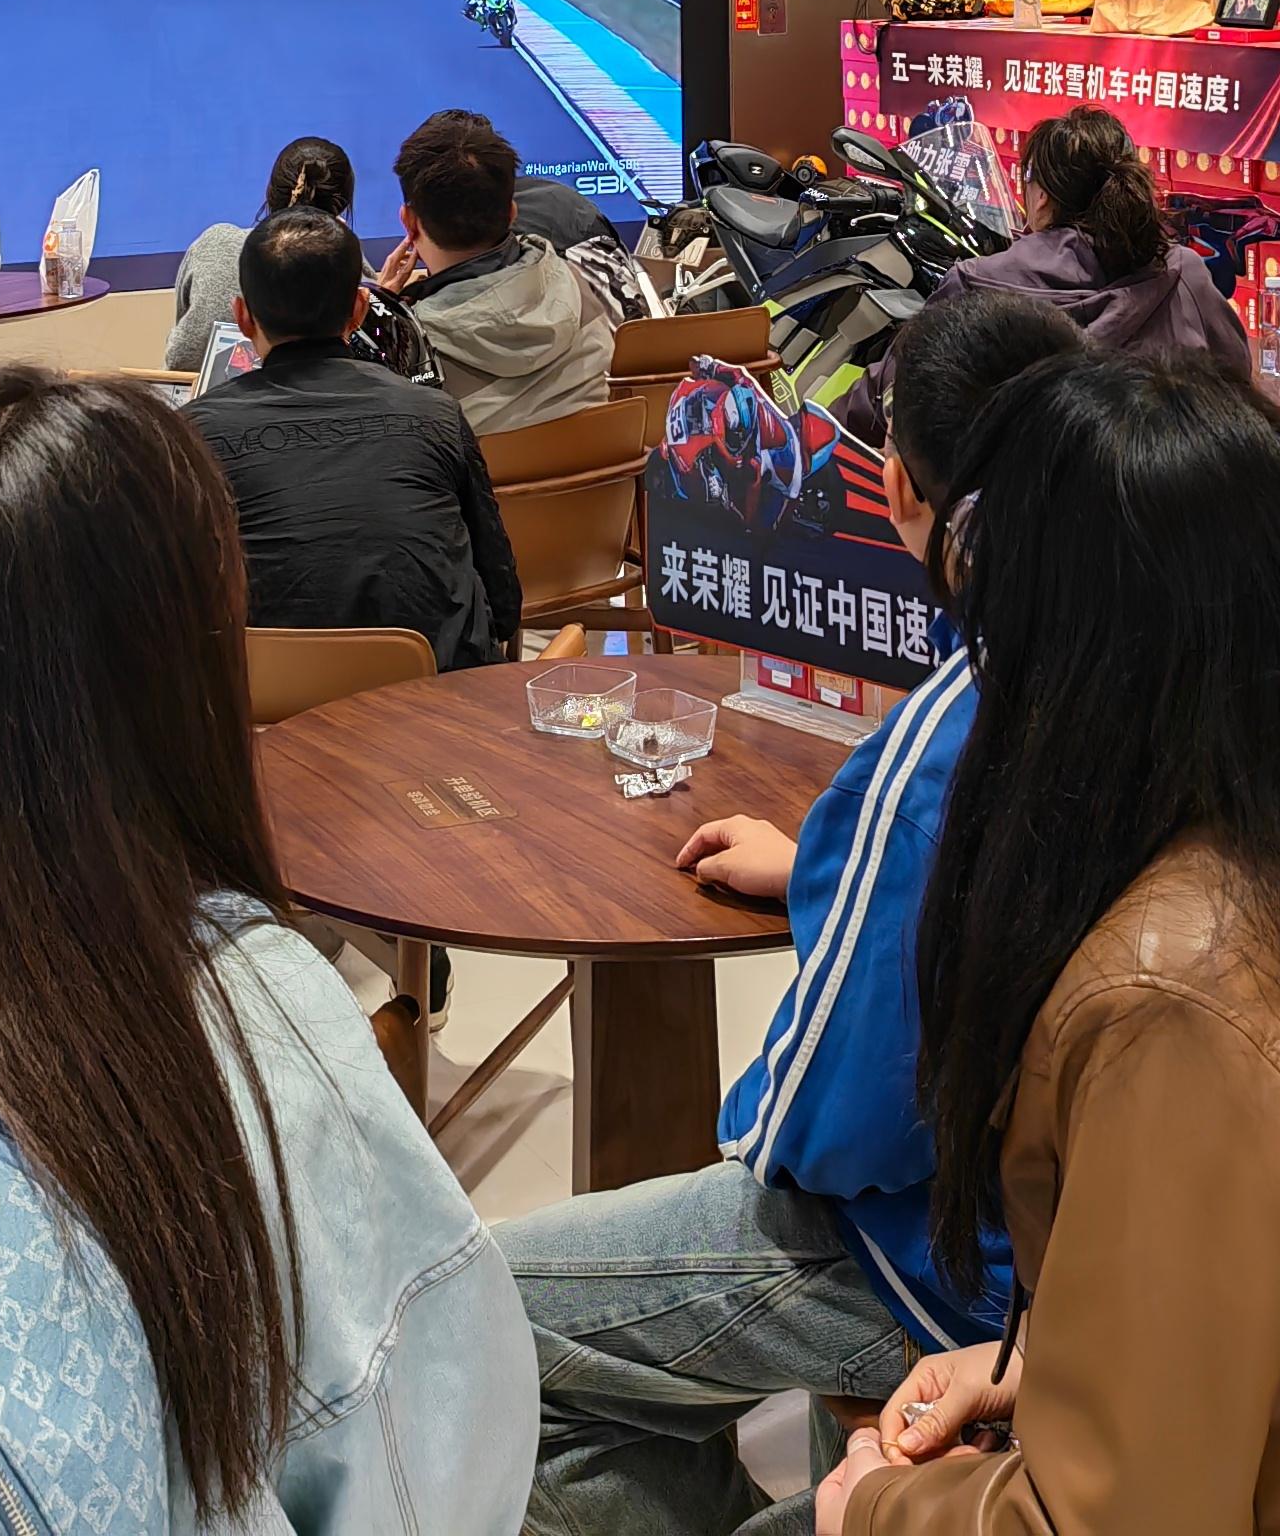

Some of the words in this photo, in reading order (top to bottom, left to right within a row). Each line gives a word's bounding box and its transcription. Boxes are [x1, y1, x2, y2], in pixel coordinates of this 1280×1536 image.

[892, 52, 1240, 113] 五一来荣耀，见证张雪机车中国速度！
[907, 140, 971, 182] 助力张雪
[670, 405, 684, 443] 53
[660, 540, 752, 621] 来荣耀
